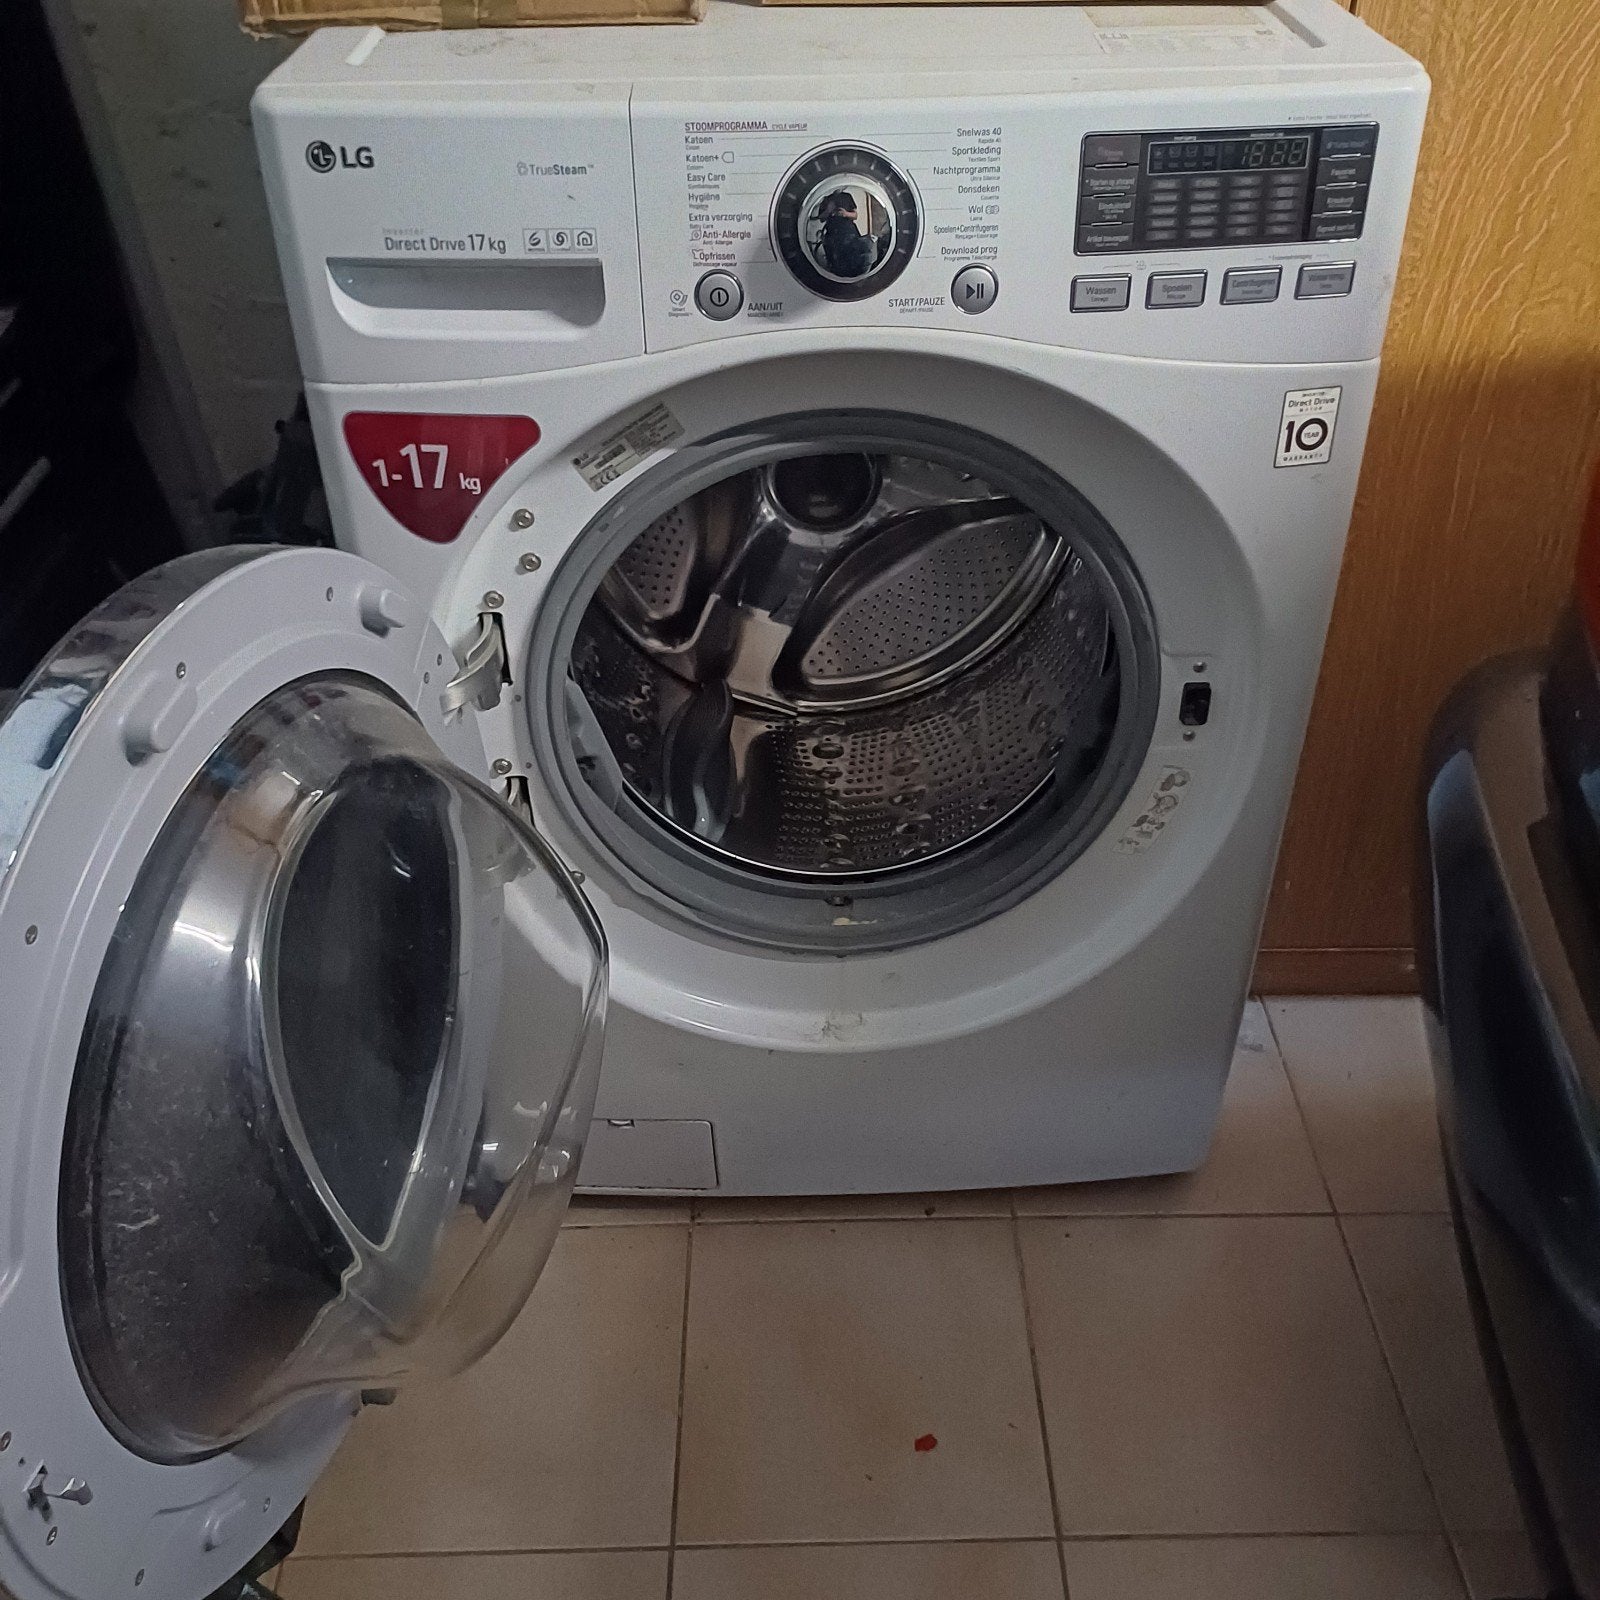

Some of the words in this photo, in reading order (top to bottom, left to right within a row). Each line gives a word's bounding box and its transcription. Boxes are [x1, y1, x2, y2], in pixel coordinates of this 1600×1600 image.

[685, 121, 768, 132] STOOMPROGRAMMA
[956, 128, 991, 137] Snelwas
[992, 127, 1002, 136] 40
[684, 135, 714, 144] Katoen
[952, 146, 1002, 156] Sportkleding
[340, 145, 375, 169] LG
[685, 154, 720, 163] Katoen+
[933, 166, 1001, 176] Nachtprogramma
[686, 173, 706, 183] Easy
[707, 172, 726, 182] Care
[957, 185, 1000, 194] Donsdeken
[968, 205, 984, 214] Wol
[688, 213, 710, 222] Extra
[711, 213, 753, 222] verzorging
[702, 230, 752, 241] Anti-Allergie
[384, 236, 427, 251] Direct
[429, 236, 466, 251] Drive
[699, 251, 736, 261] Opfrissen
[941, 246, 979, 256] Download
[980, 246, 998, 257] prog
[1085, 286, 1117, 295] Wassen
[747, 302, 783, 311] AAN/UIT
[888, 296, 946, 308] START/PAUZE
[1287, 398, 1312, 408] Direct
[1313, 397, 1336, 406] Drive
[1284, 417, 1329, 453] 10
[459, 472, 482, 495] kg
